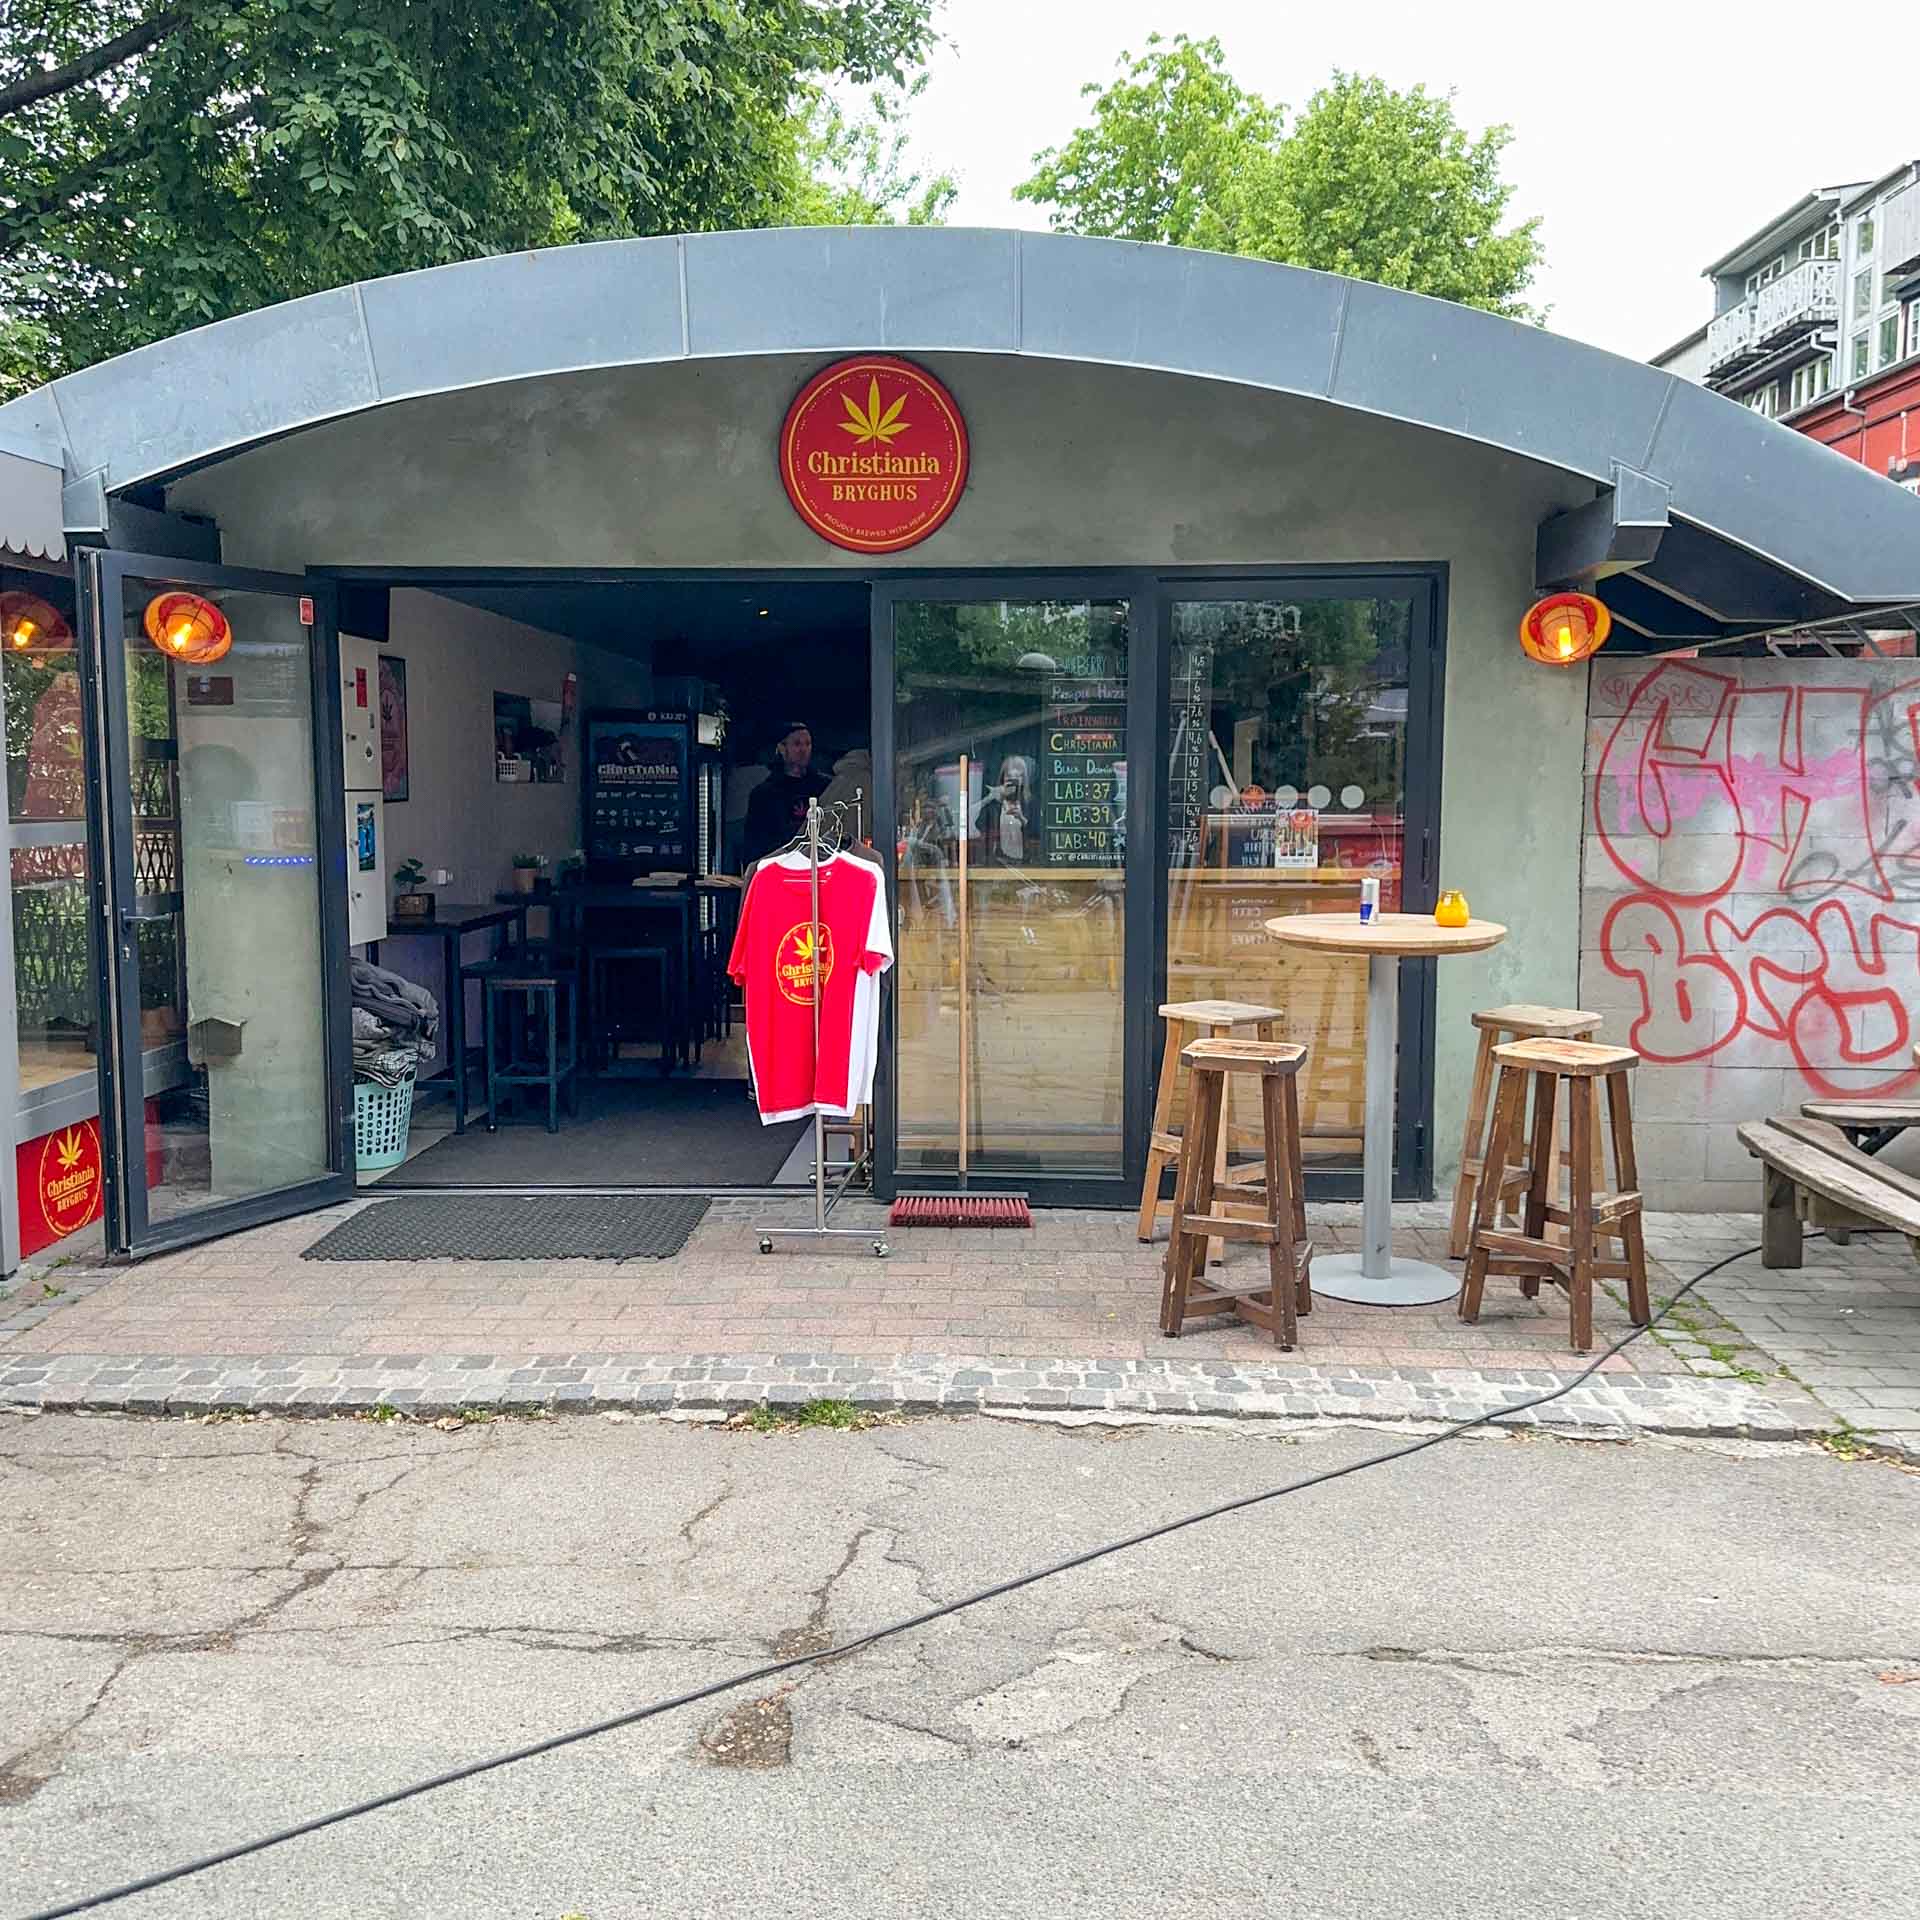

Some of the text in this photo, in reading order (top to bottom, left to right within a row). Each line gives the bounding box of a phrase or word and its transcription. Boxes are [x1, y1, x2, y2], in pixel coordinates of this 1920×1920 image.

[808, 450, 941, 475] Christiania
[832, 484, 918, 502] BRYGHUS
[855, 528, 887, 537] BREWED
[888, 525, 908, 536] WITH
[1193, 681, 1201, 693] 6
[1051, 733, 1118, 752] CHRISTIANIA
[1189, 756, 1199, 768] 10
[1187, 781, 1198, 792] 15
[47, 1165, 96, 1198] Christiania
